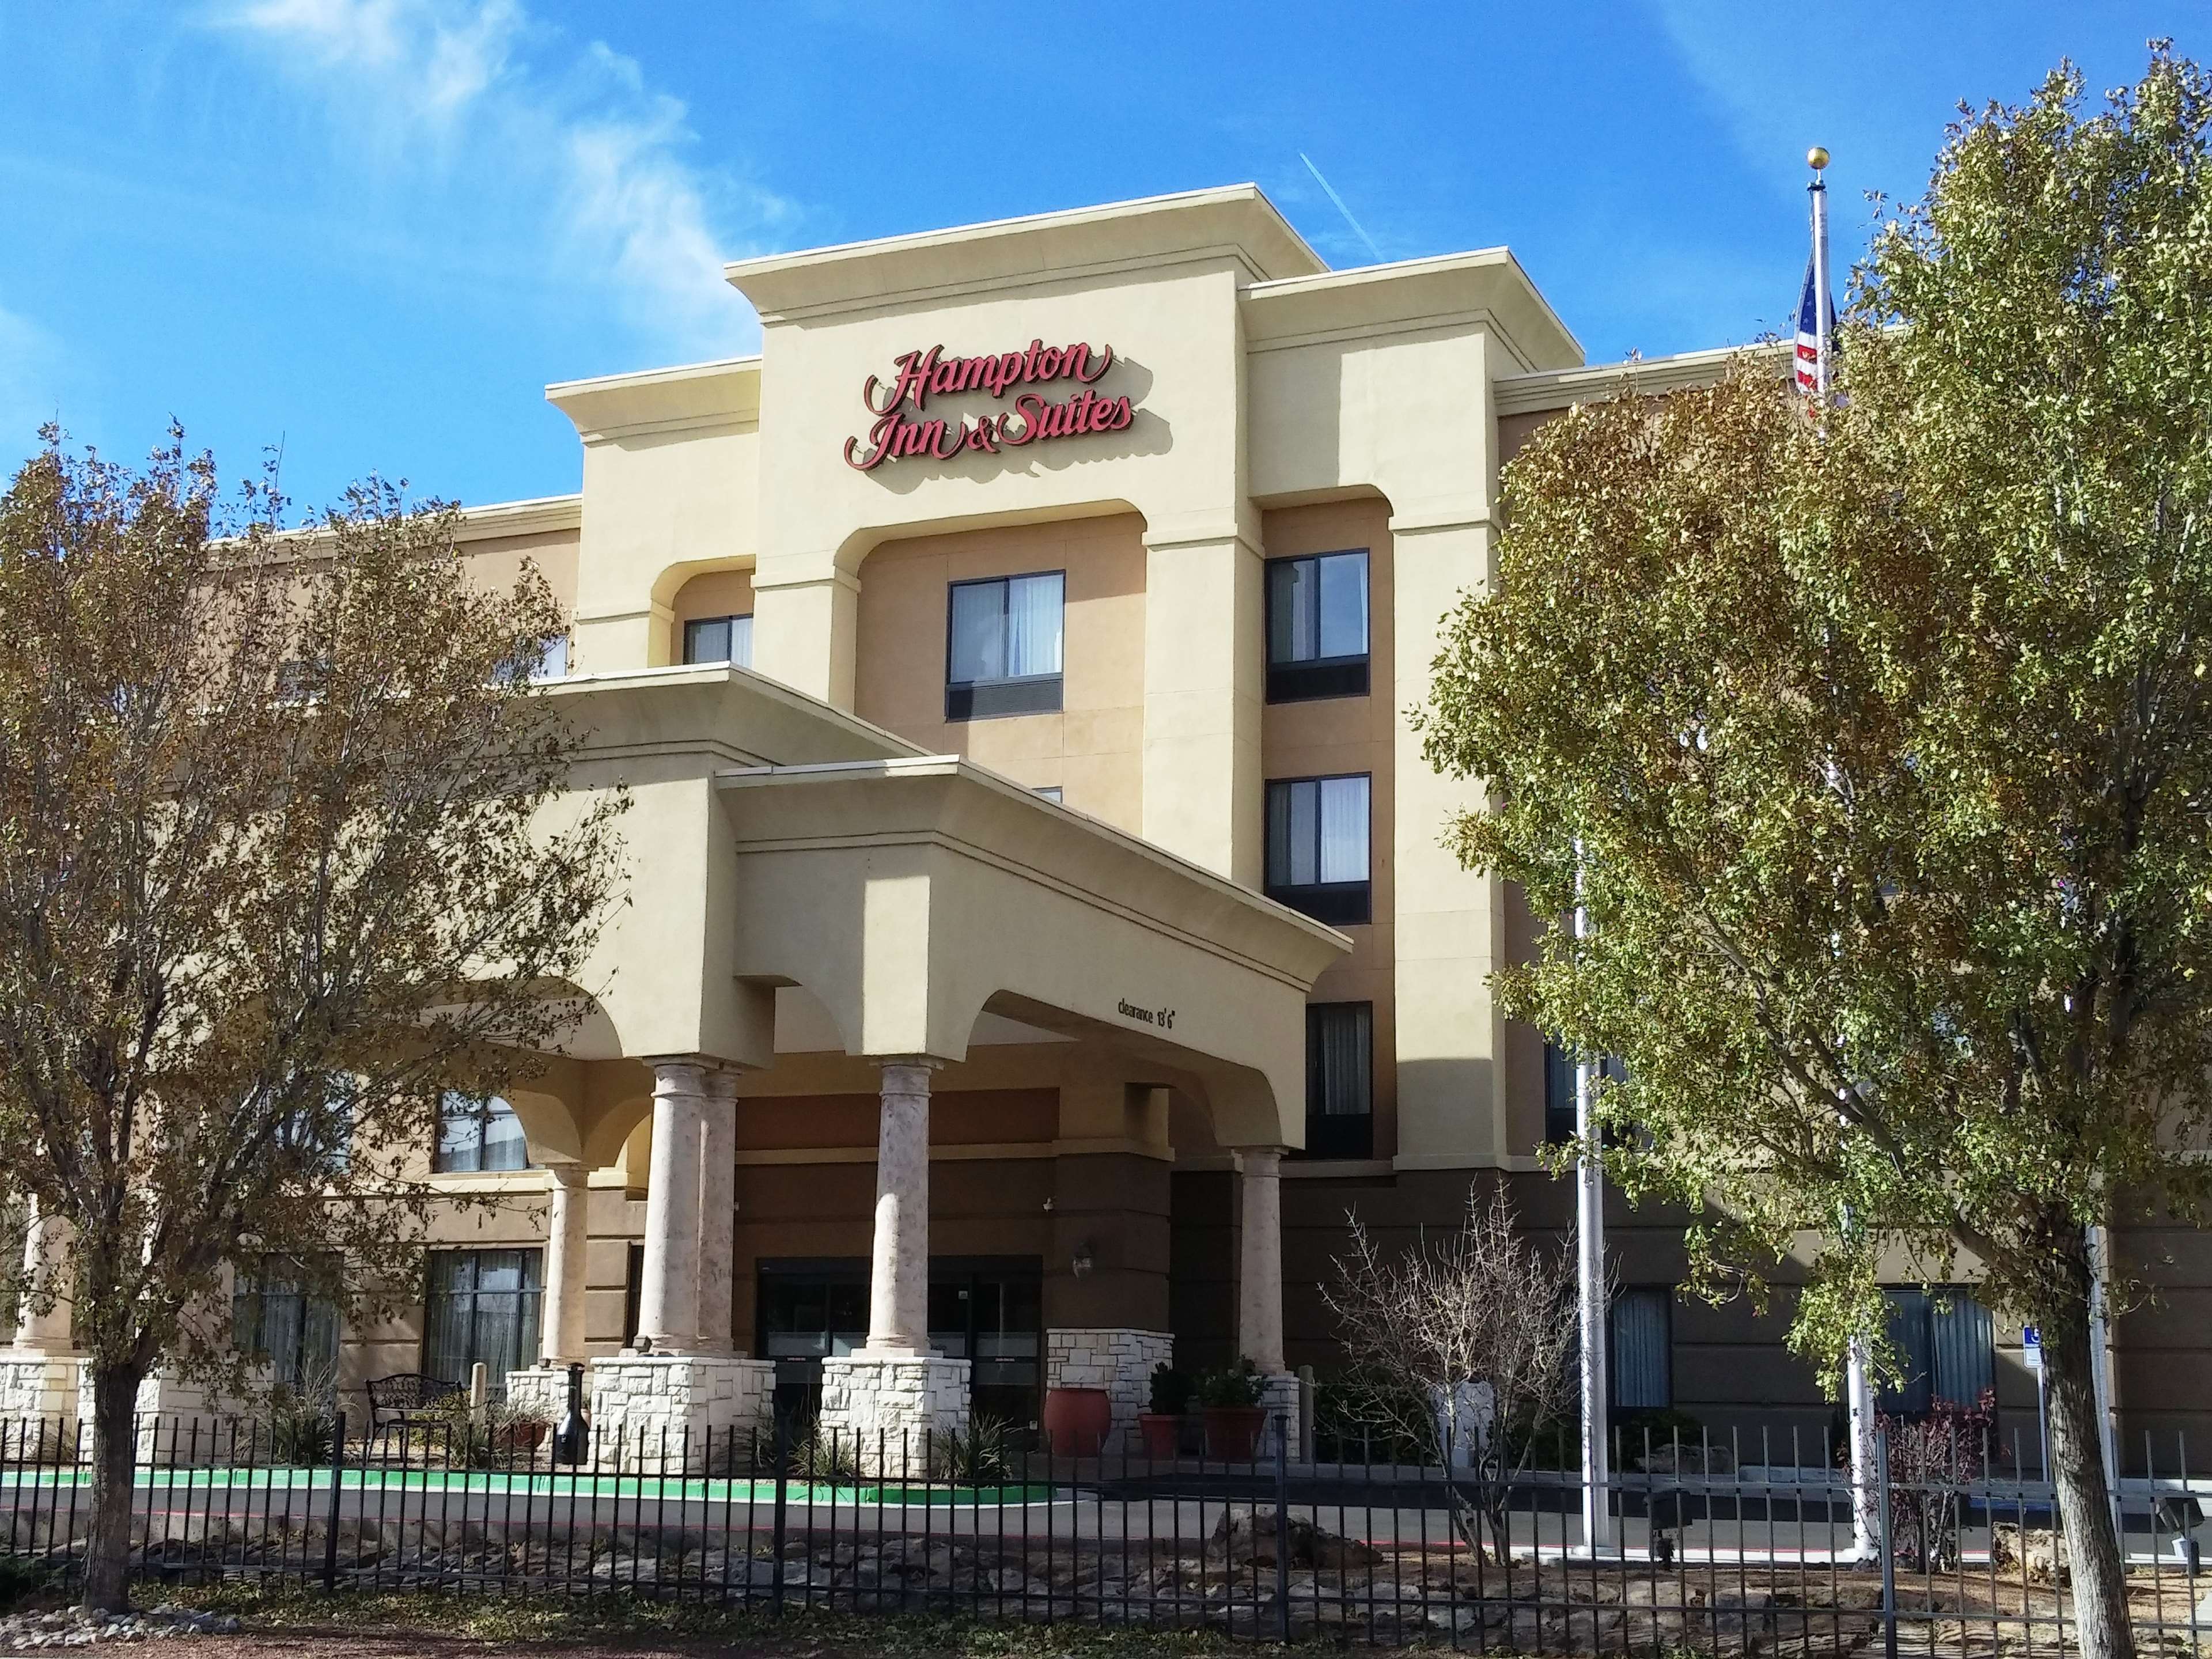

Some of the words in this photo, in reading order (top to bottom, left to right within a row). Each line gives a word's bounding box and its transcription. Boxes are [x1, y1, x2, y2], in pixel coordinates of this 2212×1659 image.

[863, 339, 1113, 416] Hampton
[844, 412, 968, 471] Inn
[967, 415, 1001, 454] &
[997, 389, 1134, 446] Suites
